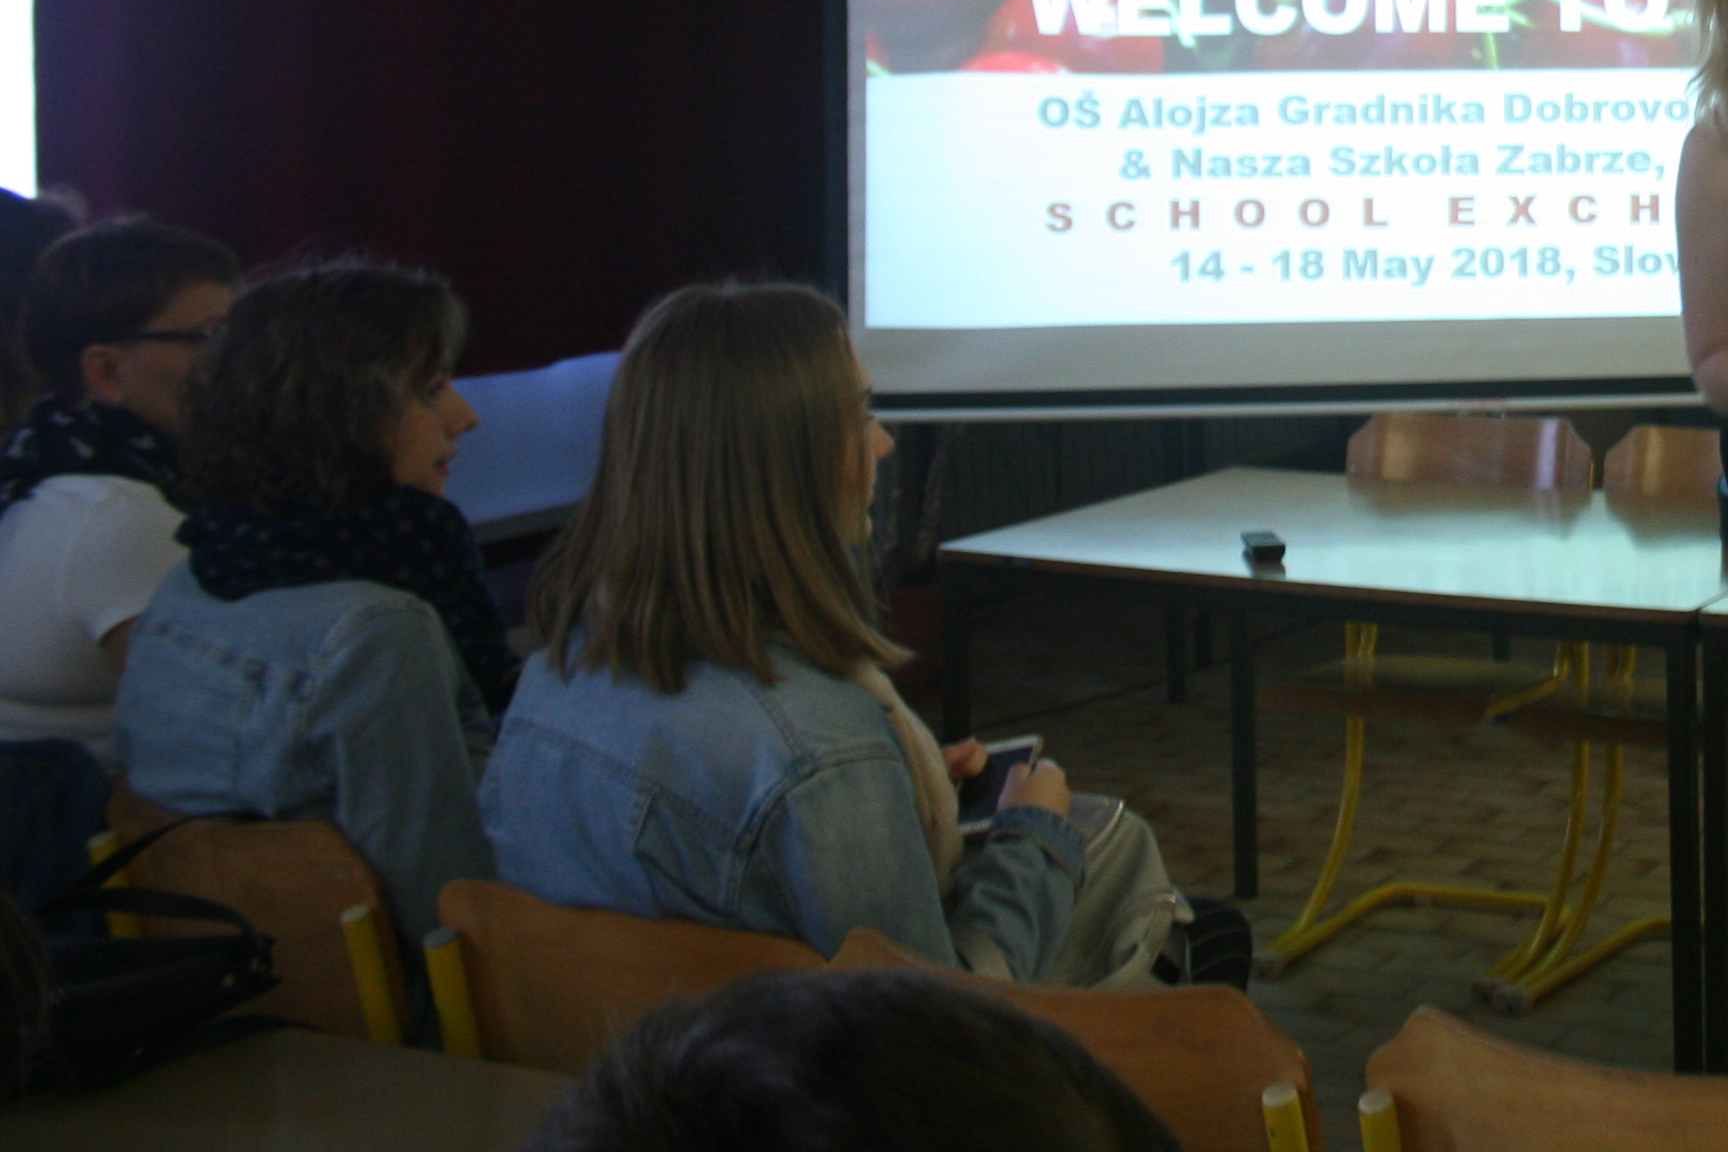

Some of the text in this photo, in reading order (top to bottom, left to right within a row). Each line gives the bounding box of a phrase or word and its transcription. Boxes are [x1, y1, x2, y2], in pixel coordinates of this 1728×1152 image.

[1039, 90, 1101, 129] OŠ
[1118, 95, 1259, 135] Alojza
[1278, 92, 1485, 126] Gradnika
[1119, 142, 1665, 180] & Nasza Szkoła Zabrze,
[1171, 249, 1225, 283] 14
[1272, 248, 1325, 281] 18
[1342, 248, 1434, 288] May
[1451, 244, 1576, 285] 2018,
